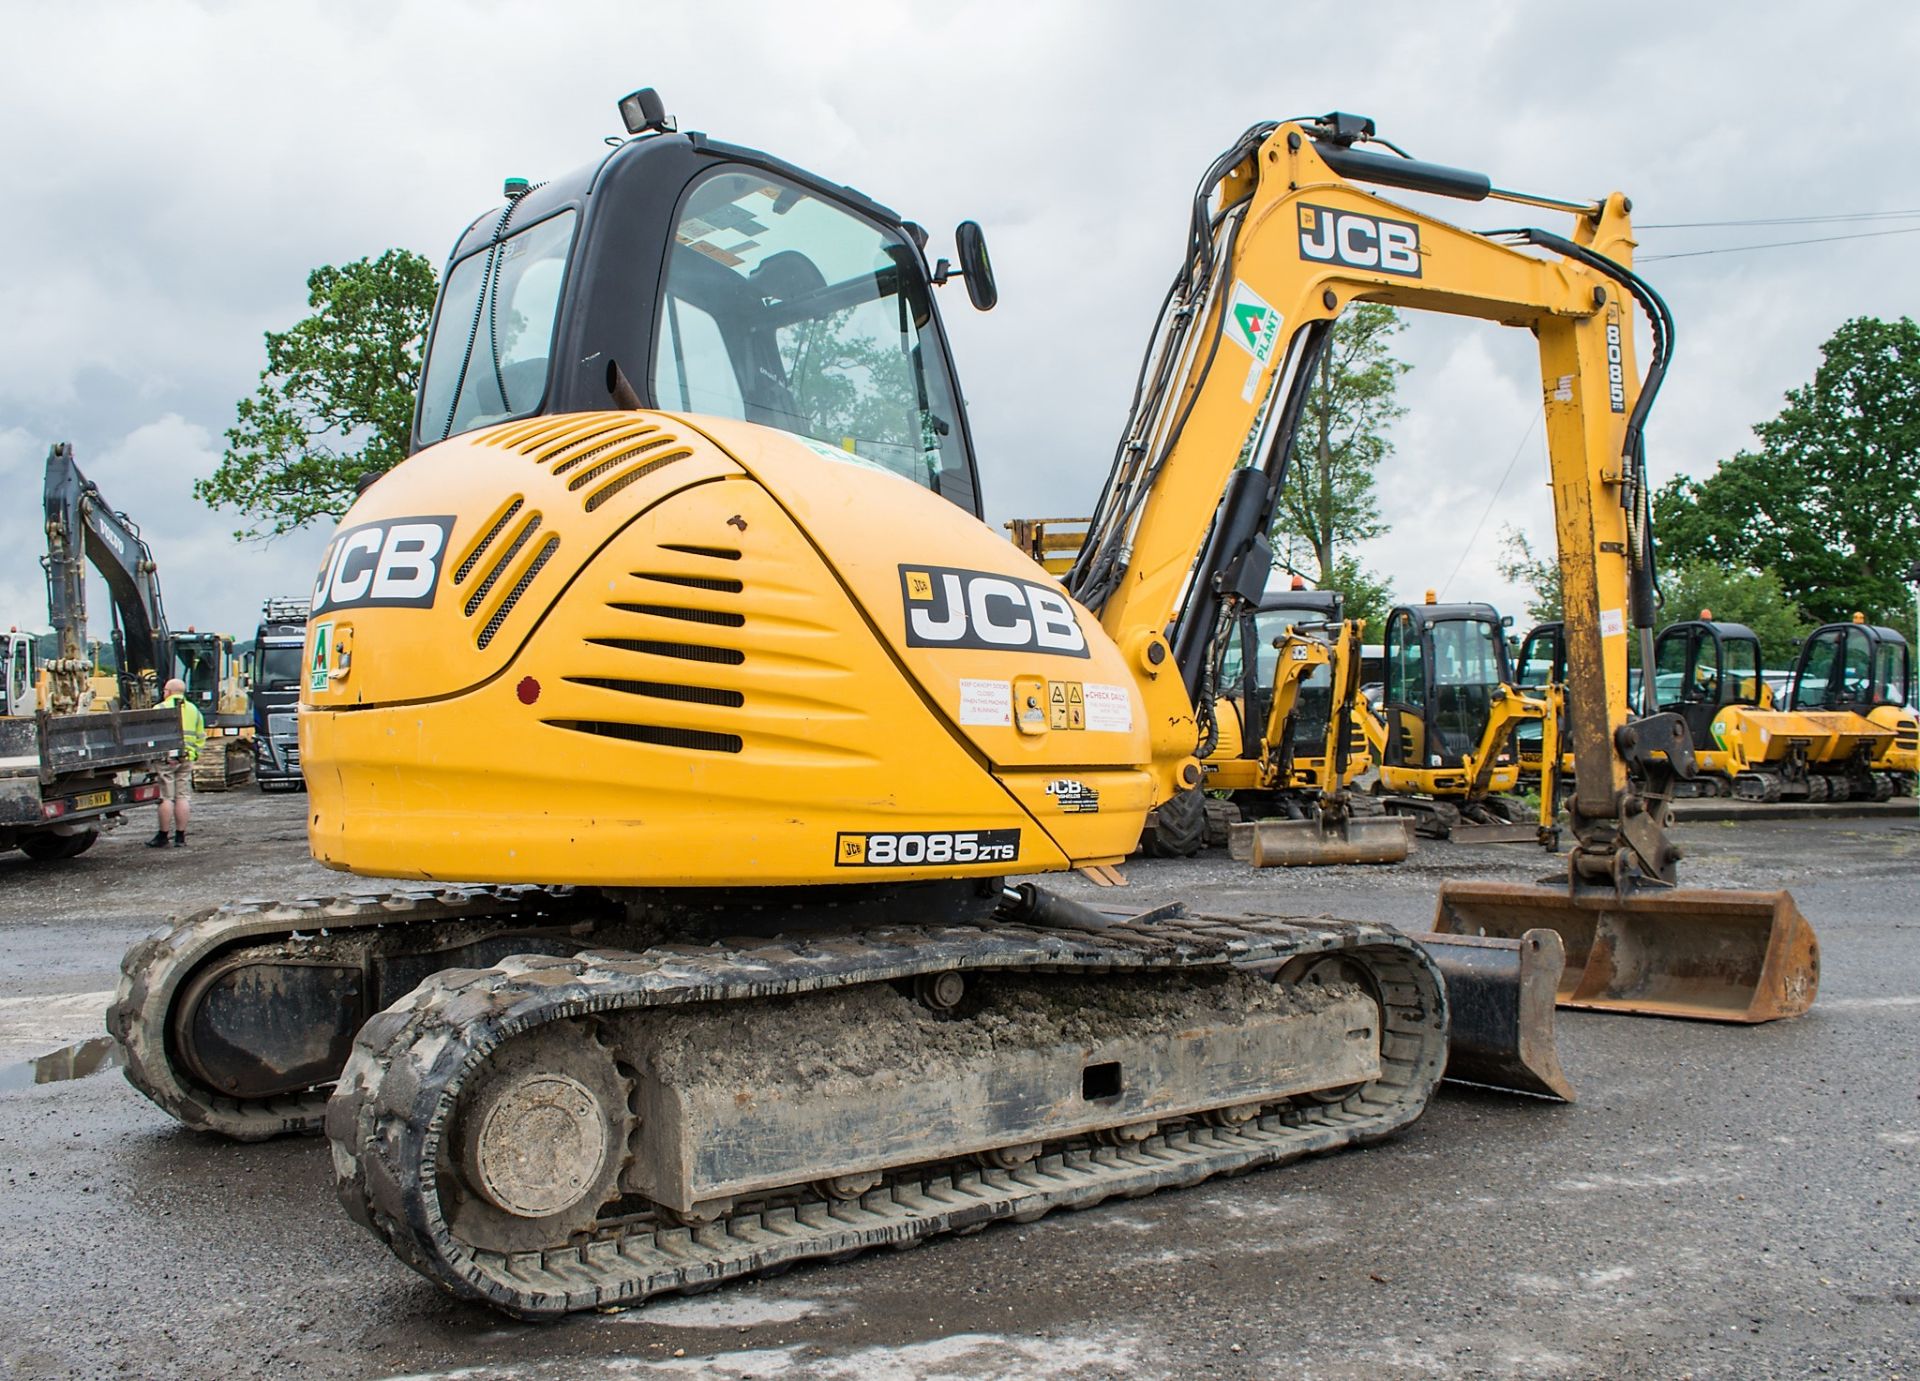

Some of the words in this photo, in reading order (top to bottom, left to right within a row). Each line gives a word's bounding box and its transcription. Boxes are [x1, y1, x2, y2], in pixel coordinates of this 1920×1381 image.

[1301, 211, 1419, 273] JCB
[1256, 311, 1281, 362] PLANT
[99, 518, 124, 555] VOLVO
[312, 523, 443, 612] JCB
[910, 574, 1085, 651] JCB
[1045, 779, 1082, 794] JCB
[845, 841, 862, 857] JCB
